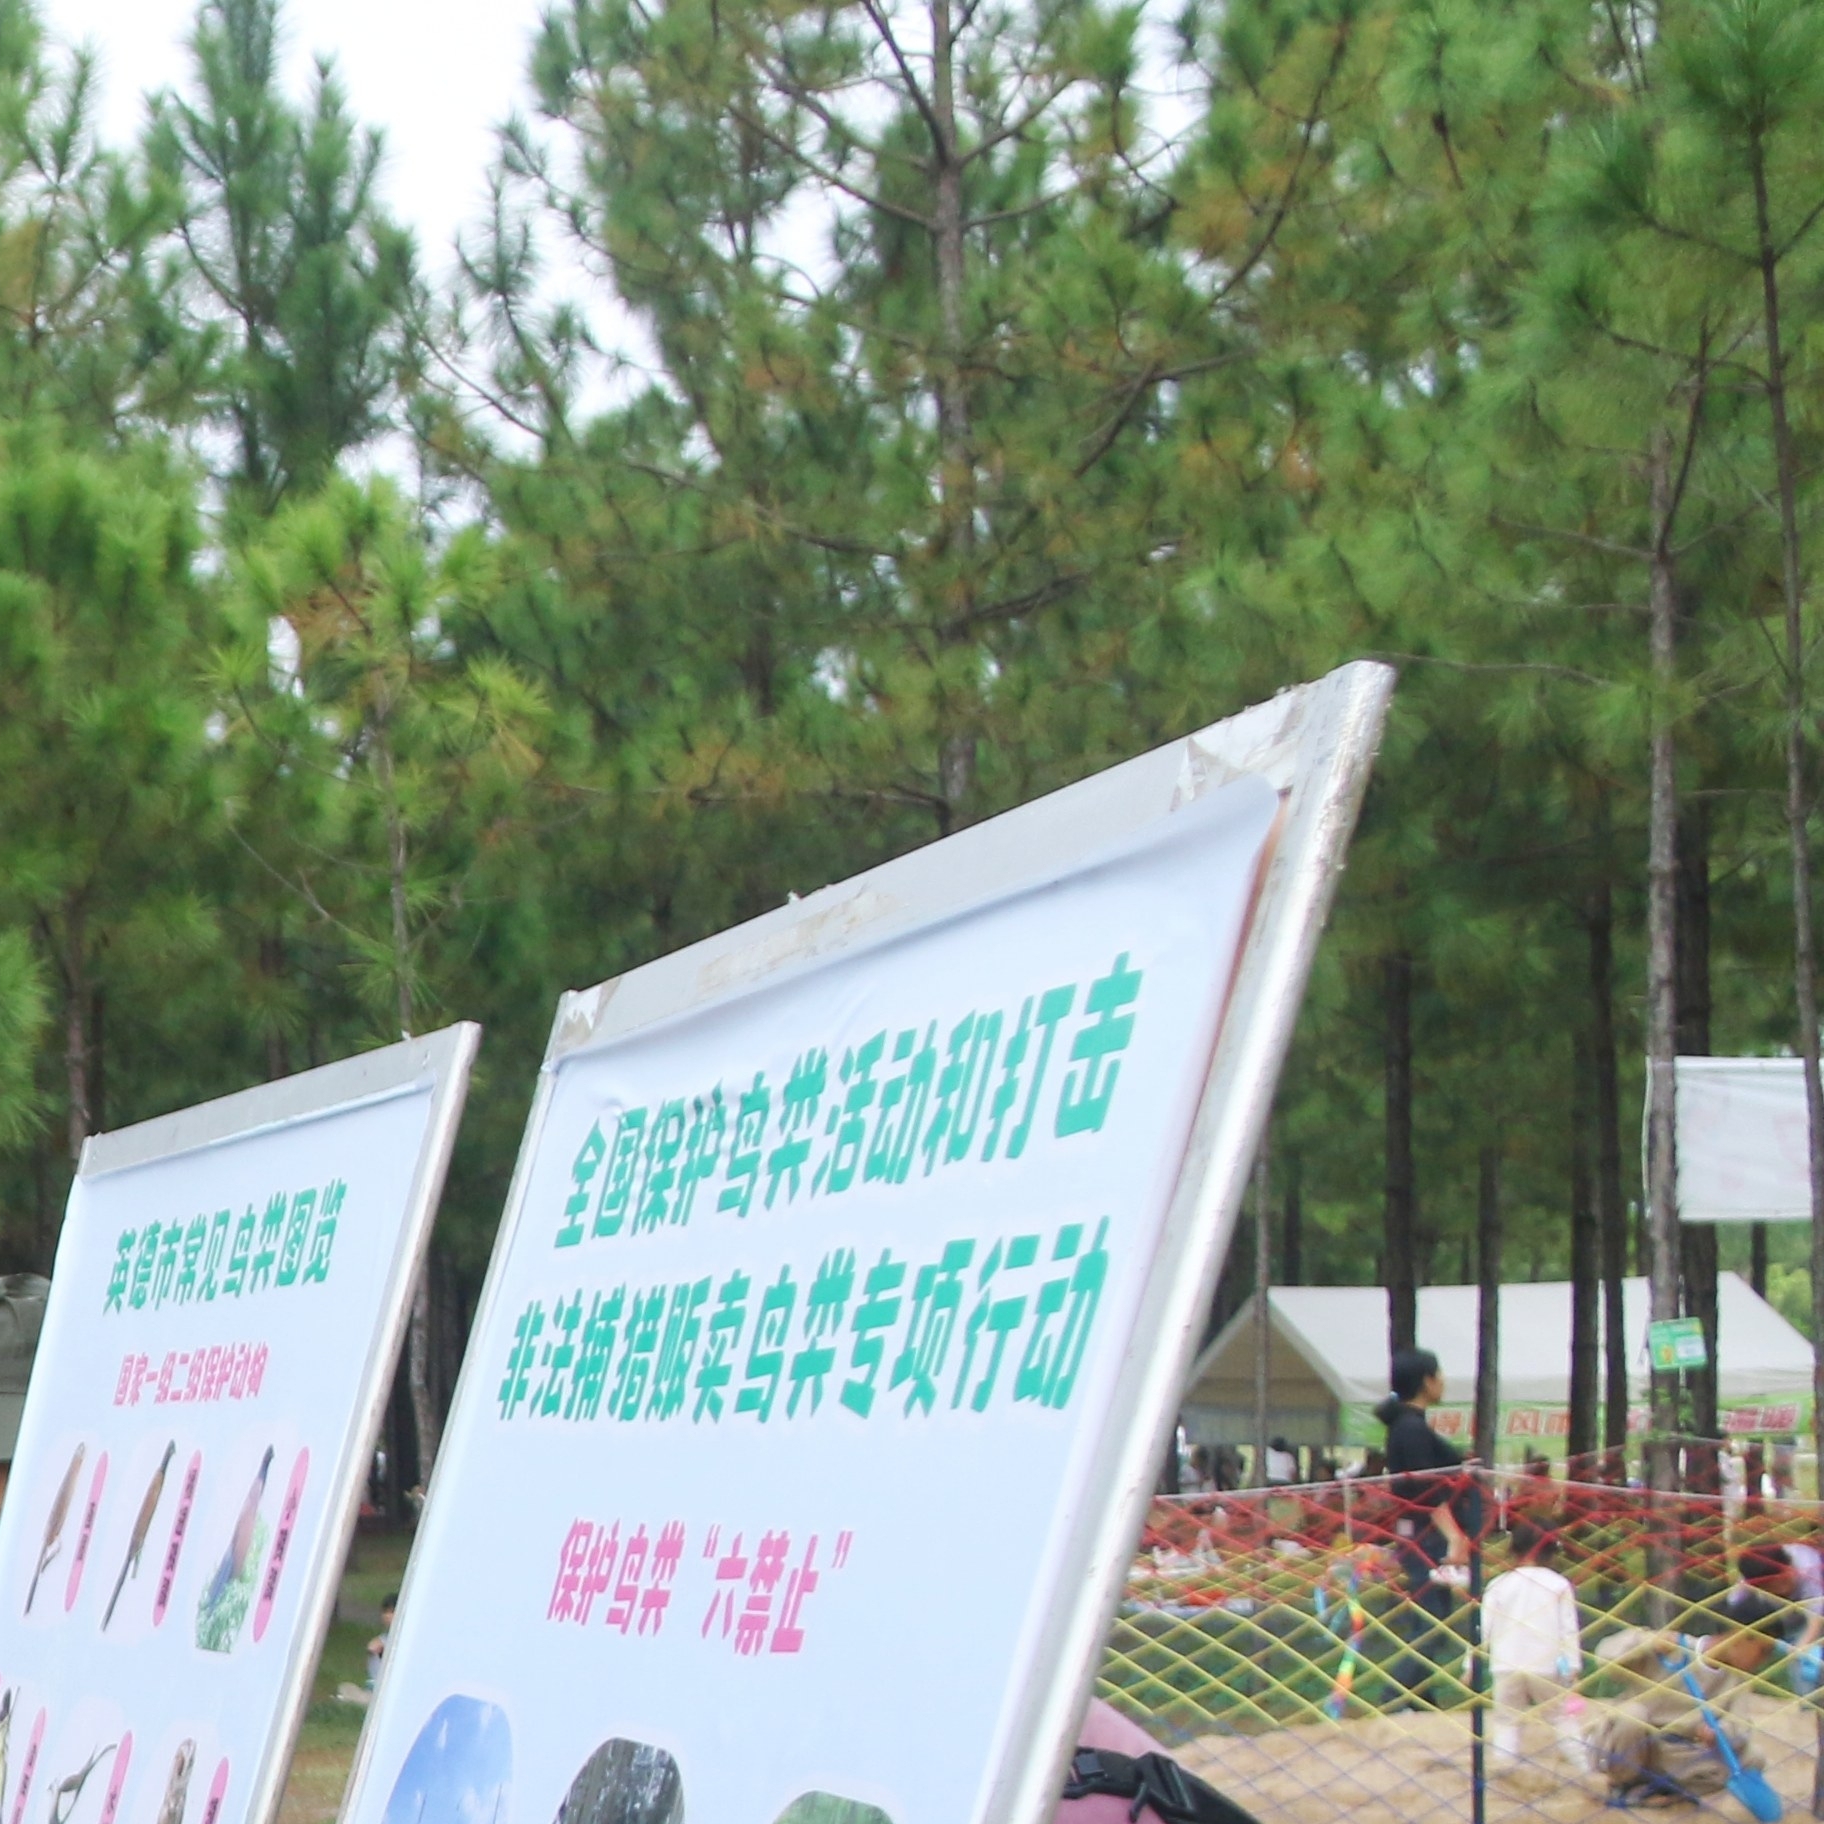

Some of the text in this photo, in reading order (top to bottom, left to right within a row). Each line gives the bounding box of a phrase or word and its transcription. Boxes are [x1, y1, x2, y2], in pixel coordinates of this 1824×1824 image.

[555, 951, 1144, 1249] 全国保护鸟类活动和打击
[102, 1178, 347, 1316] 英德市常见鸟类图览
[113, 1341, 270, 1407] 国家一级二级保护动物
[497, 1216, 1109, 1423] 非法捕猎贩卖鸟类专项行动
[547, 1515, 853, 1656] 保护鸟类“六禁止”
